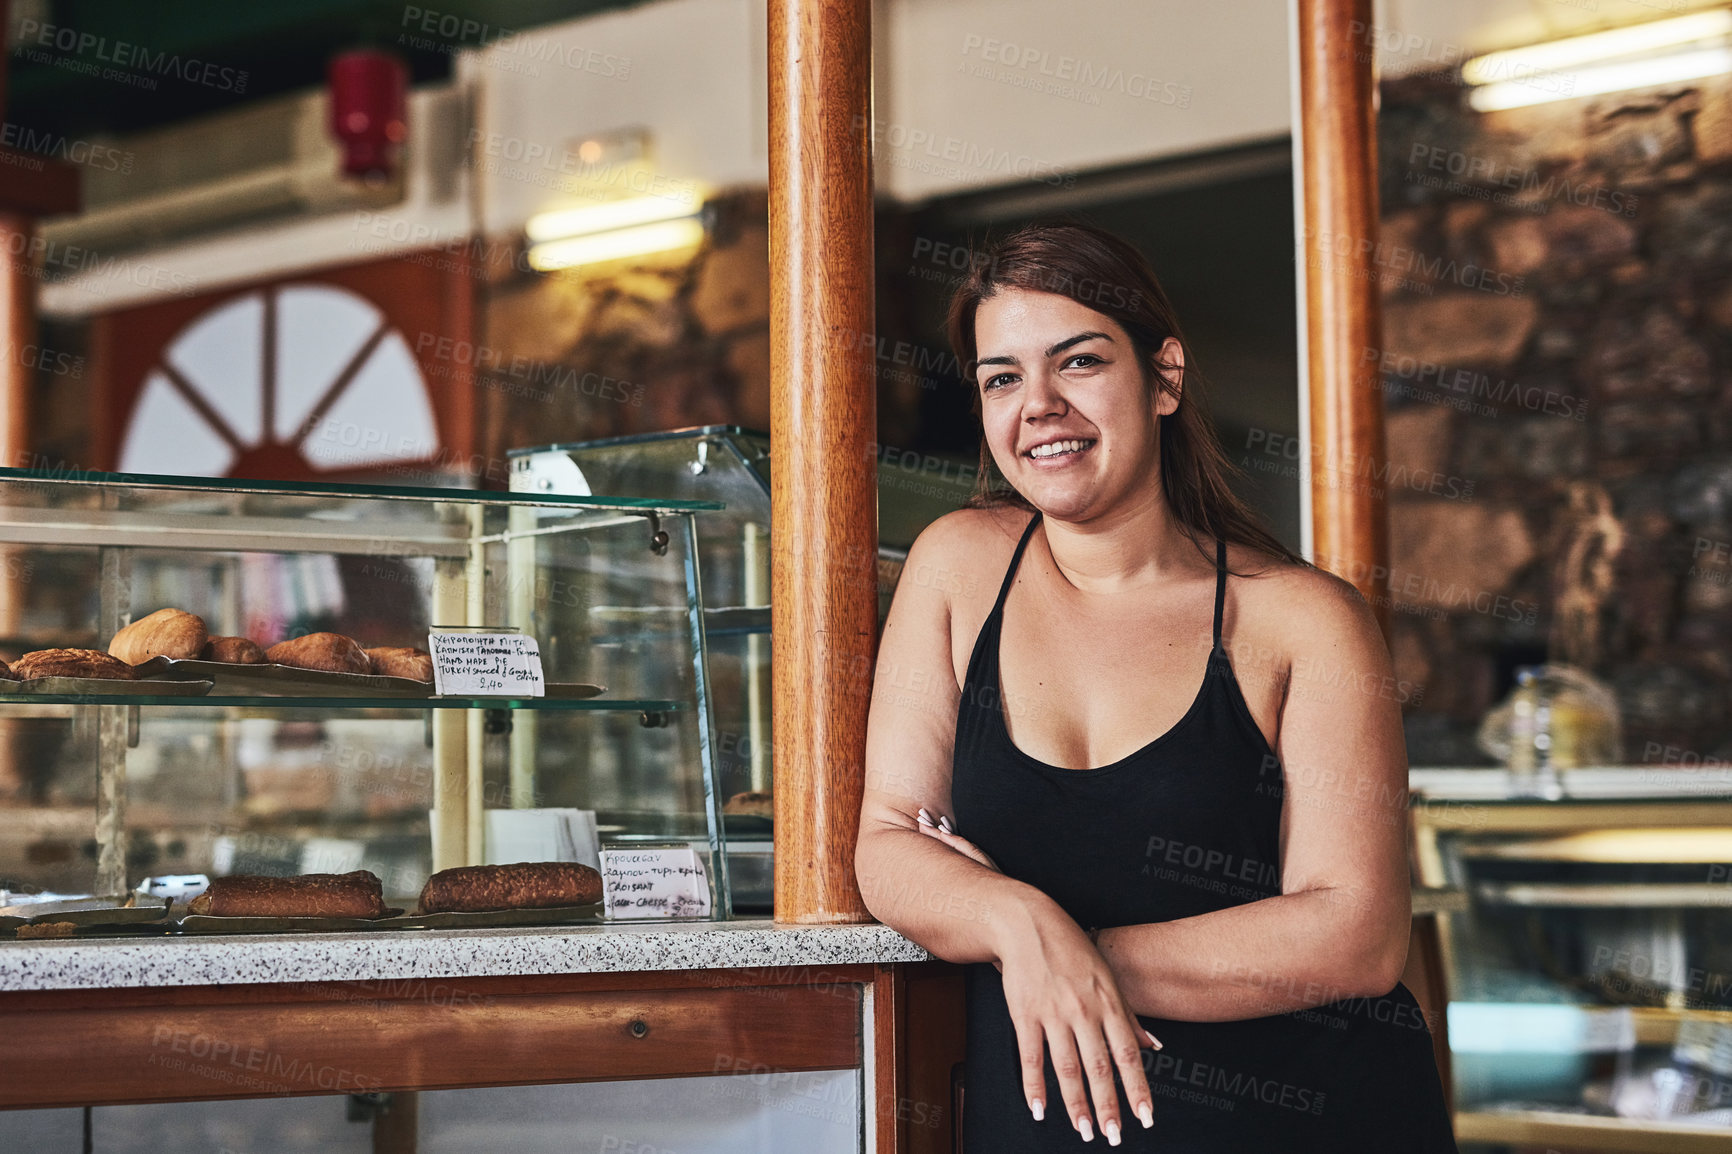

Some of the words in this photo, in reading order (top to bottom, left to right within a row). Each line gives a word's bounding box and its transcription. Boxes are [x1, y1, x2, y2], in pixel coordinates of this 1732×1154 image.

[440, 654, 463, 664] HAND
[494, 657, 507, 665] PIE
[439, 665, 471, 676] TURKEY
[480, 677, 503, 691] 2,40
